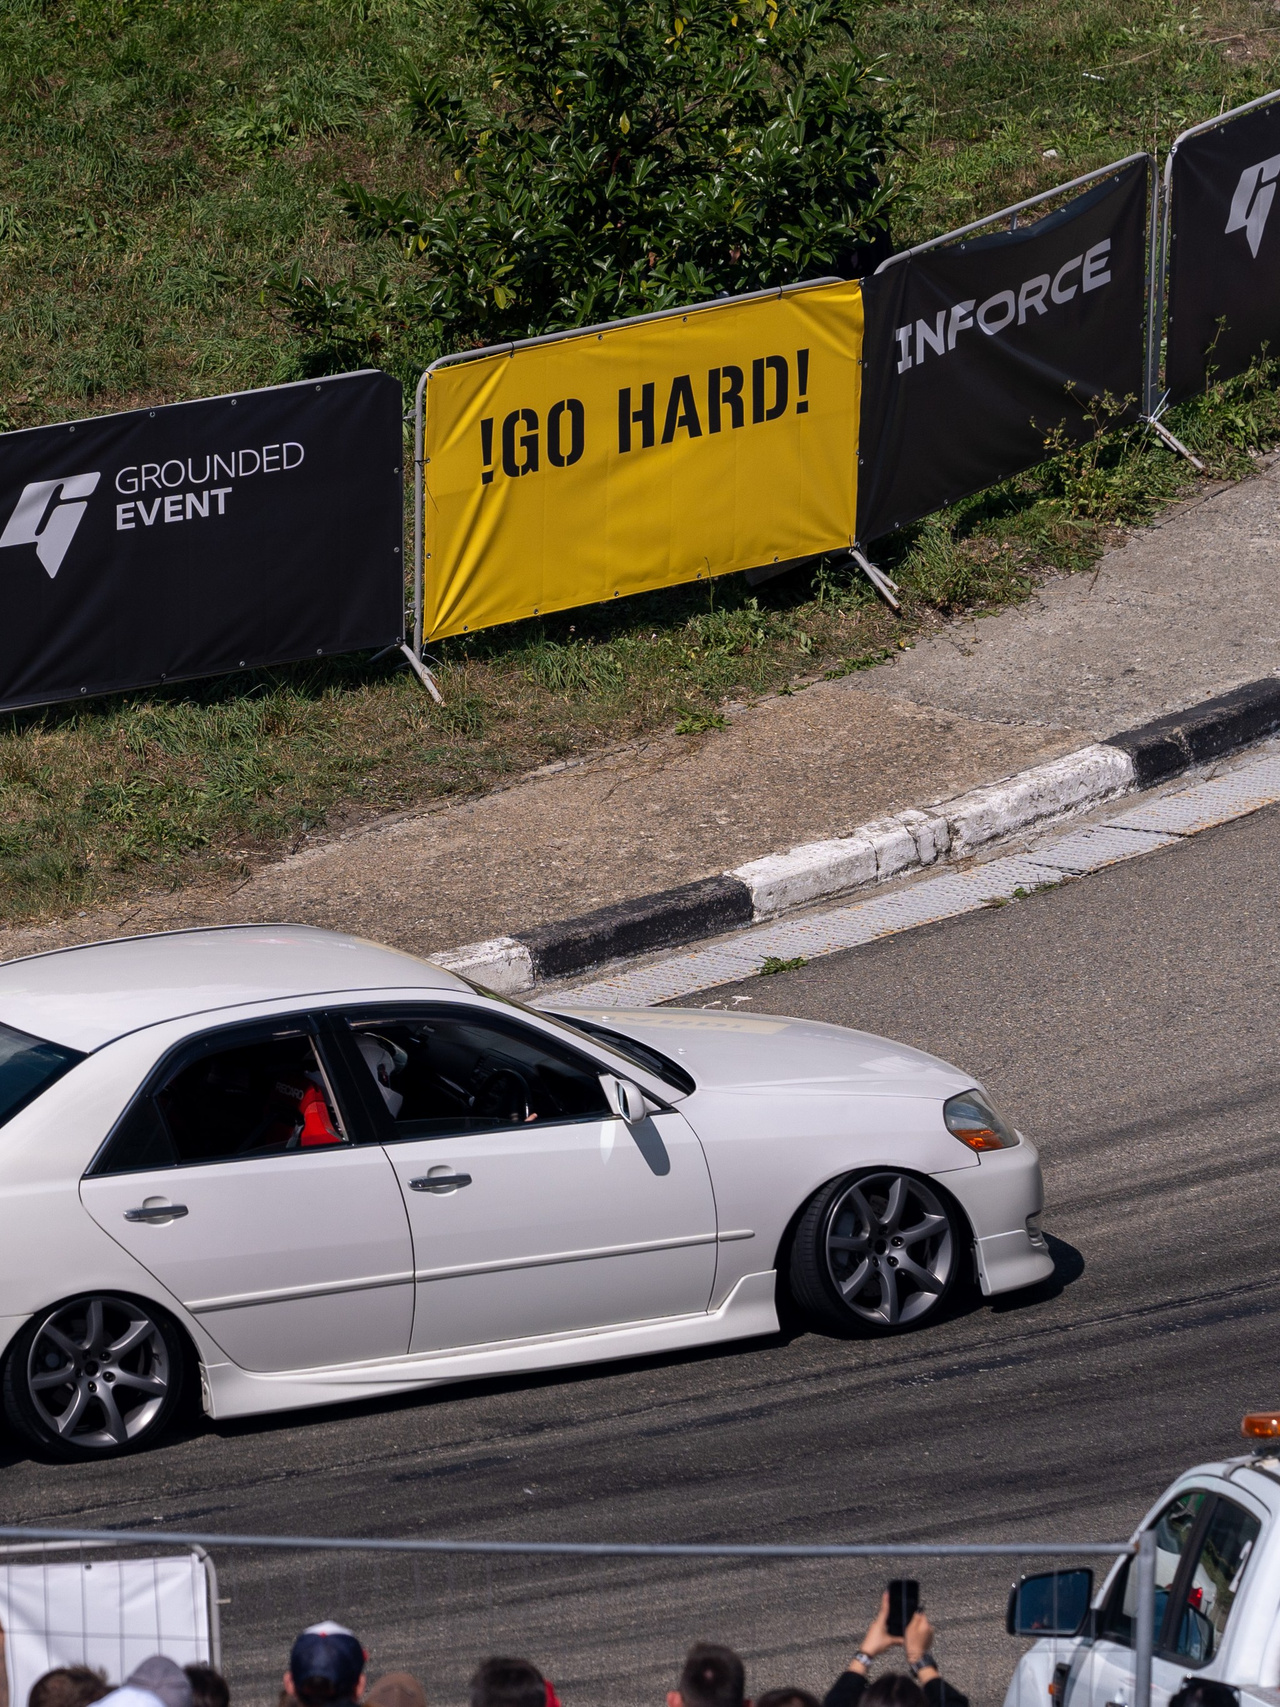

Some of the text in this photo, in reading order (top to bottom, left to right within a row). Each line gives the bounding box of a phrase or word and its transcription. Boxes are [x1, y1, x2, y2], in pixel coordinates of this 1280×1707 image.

[895, 237, 1111, 375] INFORCE
[480, 348, 810, 485] !GO HARD!
[114, 441, 306, 495] GROUNDED
[115, 486, 233, 531] EVENT
